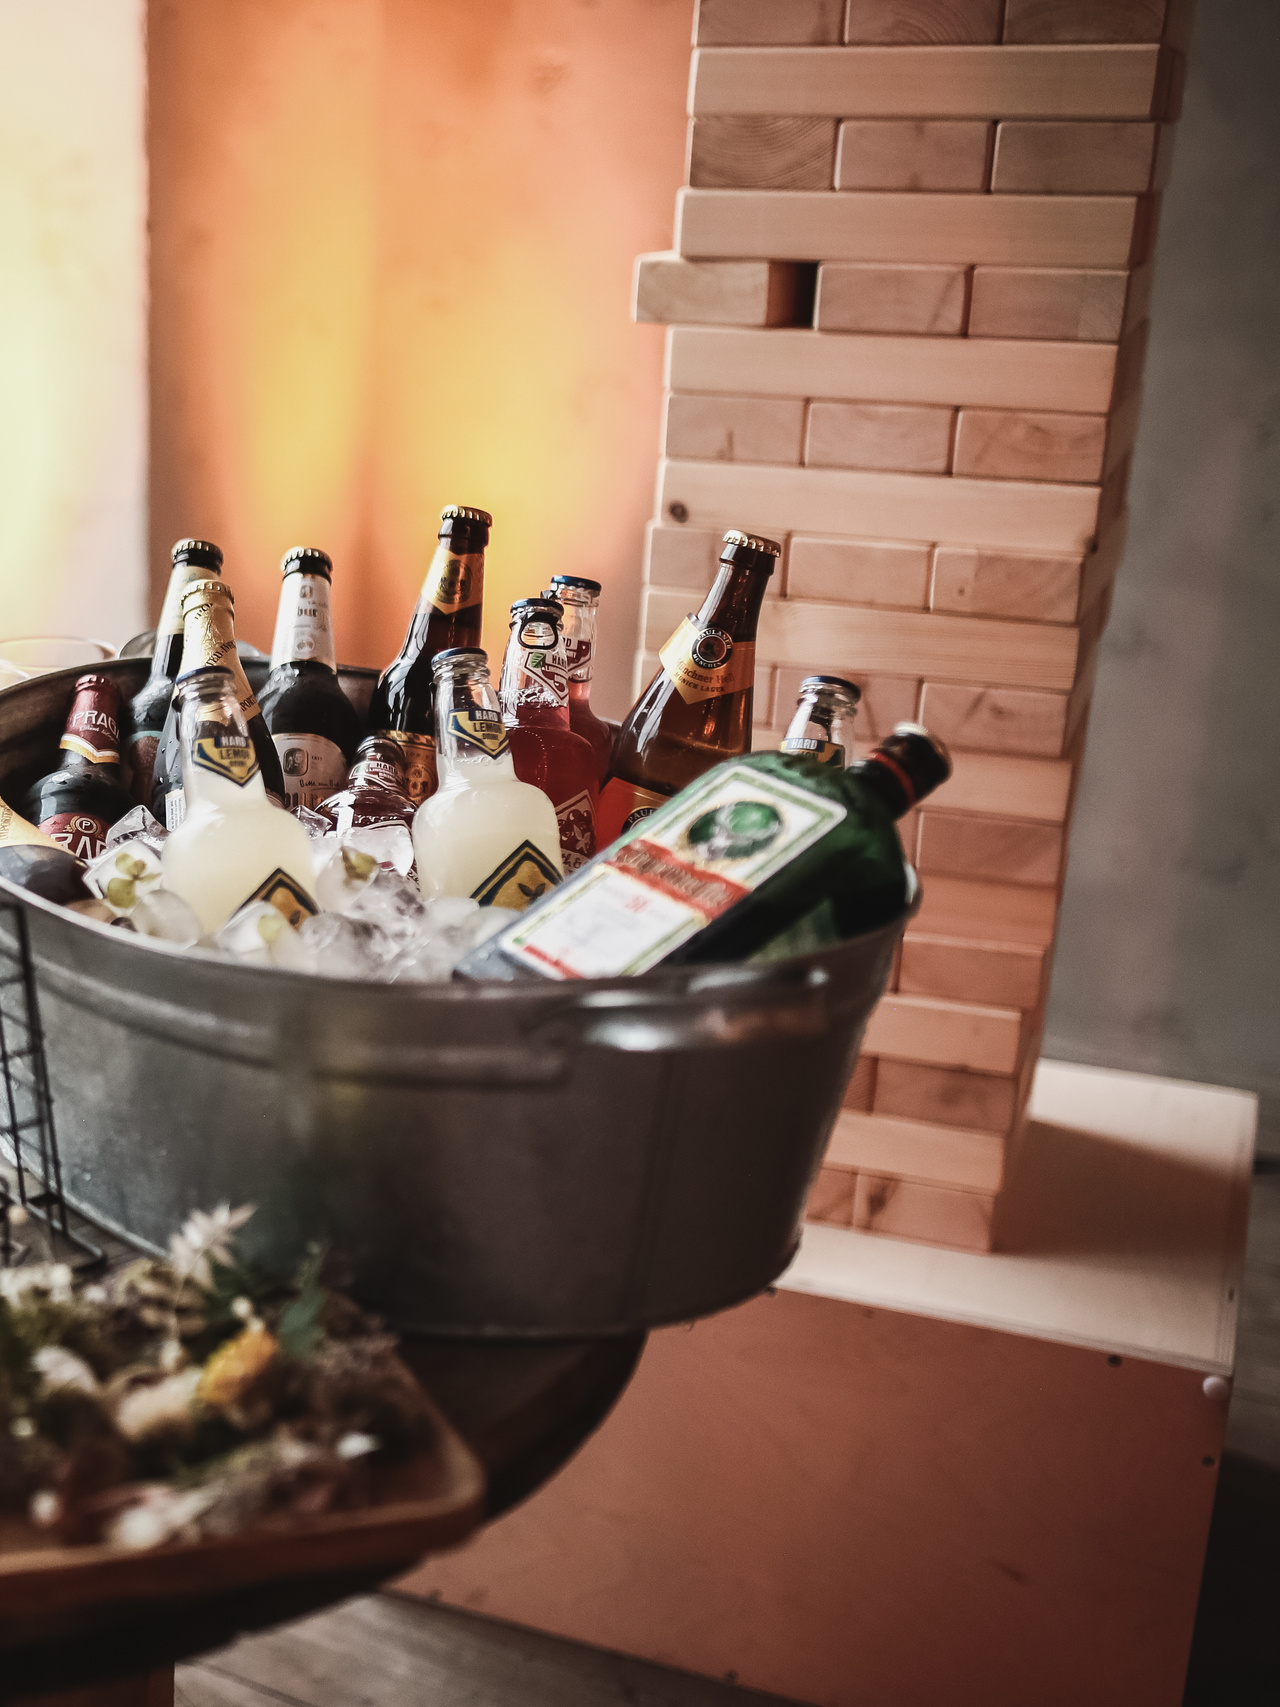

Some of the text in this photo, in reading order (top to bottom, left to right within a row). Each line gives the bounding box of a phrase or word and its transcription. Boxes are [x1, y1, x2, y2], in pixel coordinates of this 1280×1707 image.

[474, 710, 499, 721] HARD
[221, 736, 247, 748] HARD
[790, 738, 818, 750] HARD
